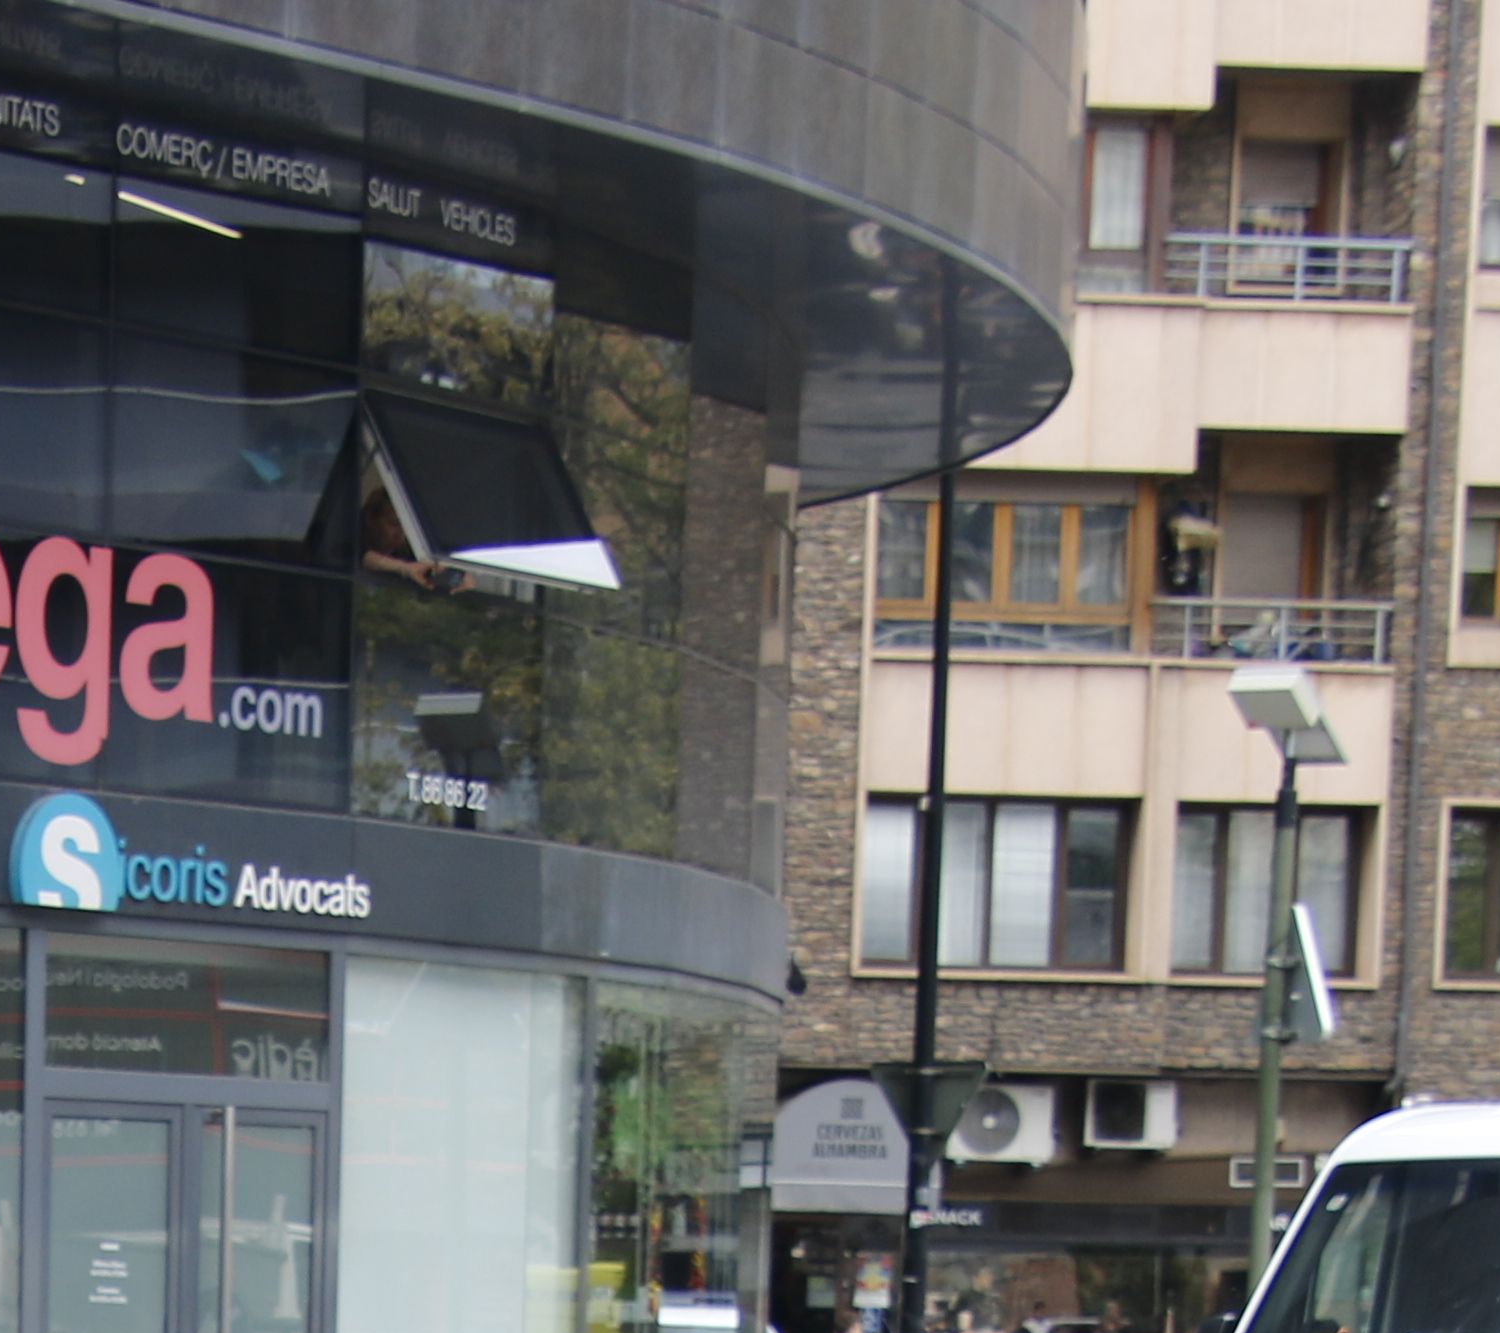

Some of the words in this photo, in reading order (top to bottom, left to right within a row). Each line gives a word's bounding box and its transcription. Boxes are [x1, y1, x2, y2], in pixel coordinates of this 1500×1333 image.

[116, 122, 214, 178] COMERÇ
[232, 146, 332, 198] EMPRESA
[367, 176, 423, 219] SALUT
[440, 198, 518, 247] VEHICLES
[466, 780, 489, 811] 22
[233, 862, 372, 919] Advocats
[811, 1142, 888, 1161] ALHAMBRA
[816, 1123, 885, 1141] CERVEZAS
